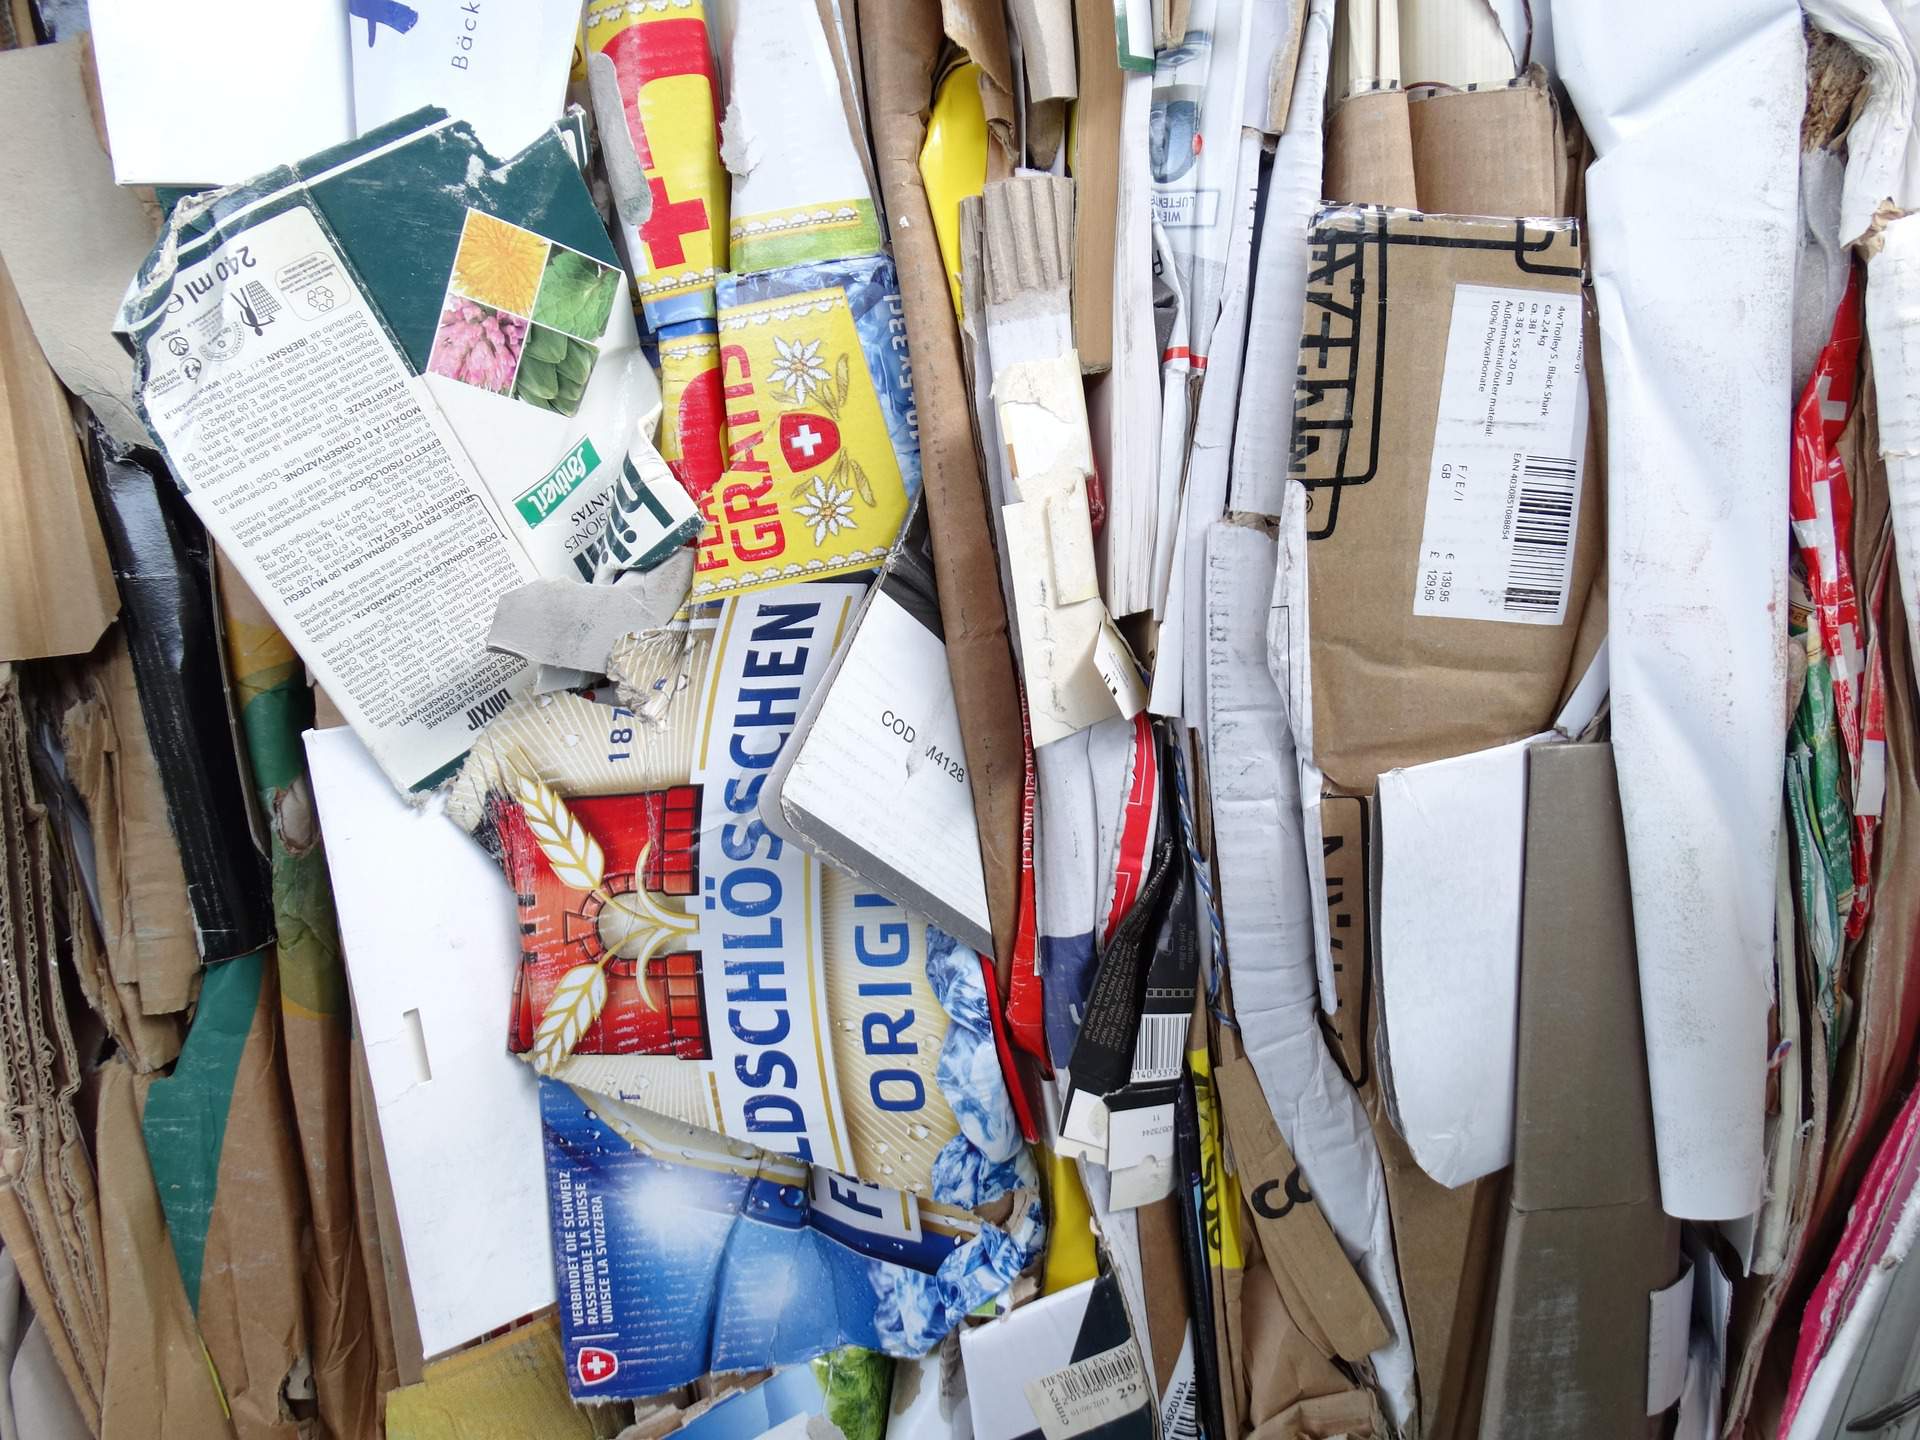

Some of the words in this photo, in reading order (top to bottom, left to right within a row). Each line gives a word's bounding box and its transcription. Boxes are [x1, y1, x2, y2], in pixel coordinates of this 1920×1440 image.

[451, 1, 481, 70] Bäck
[211, 244, 258, 283] 240
[183, 272, 217, 304] ml
[1487, 298, 1500, 324] 100%
[1516, 301, 1524, 314] ca.
[1529, 302, 1538, 315] ca.
[1543, 304, 1551, 317] ca.
[1555, 305, 1565, 320] 4w
[321, 309, 363, 335] Distribuito
[1514, 316, 1523, 328] 38
[1528, 318, 1537, 330] 38
[1539, 319, 1550, 332] 2,4
[344, 335, 378, 358] Registro
[1511, 337, 1520, 349] 55
[1536, 334, 1547, 346] kg
[1547, 320, 1563, 352] Trolley
[265, 336, 308, 362] IBERSAN
[1476, 326, 1496, 393] Polycarbonate
[306, 353, 345, 377] Ministero
[1508, 357, 1517, 369] 20
[286, 372, 307, 387] della
[1505, 371, 1514, 385] cm
[1544, 365, 1555, 389] Black
[342, 379, 405, 416] AVVERTENZE:
[366, 387, 410, 414] conservare
[1540, 391, 1551, 417] Shark
[323, 411, 342, 426] Non
[282, 421, 322, 447] eccedere
[361, 430, 372, 440] DI
[247, 448, 270, 465] dose
[279, 436, 361, 484] CONSERVAZIONE:
[302, 443, 325, 459] dalla
[403, 437, 441, 462] EFFETTO
[1511, 452, 1521, 471] EAN
[199, 460, 247, 491] giornaliera
[254, 466, 279, 485] Dopo
[346, 457, 403, 493] FISIOLOGICO:
[404, 451, 451, 482] Maggiorana
[1440, 463, 1451, 479] GB
[227, 479, 277, 510] Conservare
[318, 487, 346, 507] Agisce
[349, 494, 376, 513] Cardo
[413, 485, 469, 521] INGREDIENTI
[334, 507, 351, 521] 417
[423, 511, 442, 526] PER
[364, 517, 412, 549] VEGETALI:
[398, 521, 424, 540] DOSE
[474, 530, 497, 548] DOSE
[322, 544, 363, 572] Genziana
[340, 534, 400, 573] GIORNALIERA
[421, 543, 475, 579] GIORNALIERA
[309, 575, 327, 590] ML)
[1422, 568, 1437, 601] 129,95
[1438, 570, 1452, 602] 139,95
[282, 585, 311, 606] DEGLI
[351, 574, 422, 621] RACCOMANDATA:
[461, 675, 490, 697] PIANTE
[490, 669, 500, 679] DI
[424, 694, 475, 730] ALIMENTARE
[879, 709, 917, 744] COD
[560, 1170, 574, 1228] SCHWEIZ
[575, 1182, 589, 1226] SUISSE
[591, 1194, 606, 1254] SVIZZERA
[565, 1230, 576, 1251] DIE
[580, 1229, 591, 1246] LA
[597, 1257, 608, 1274] LA
[568, 1254, 583, 1326] VERBINDET
[582, 1249, 598, 1325] RASSEMBLE
[599, 1277, 612, 1323] UNISCE
